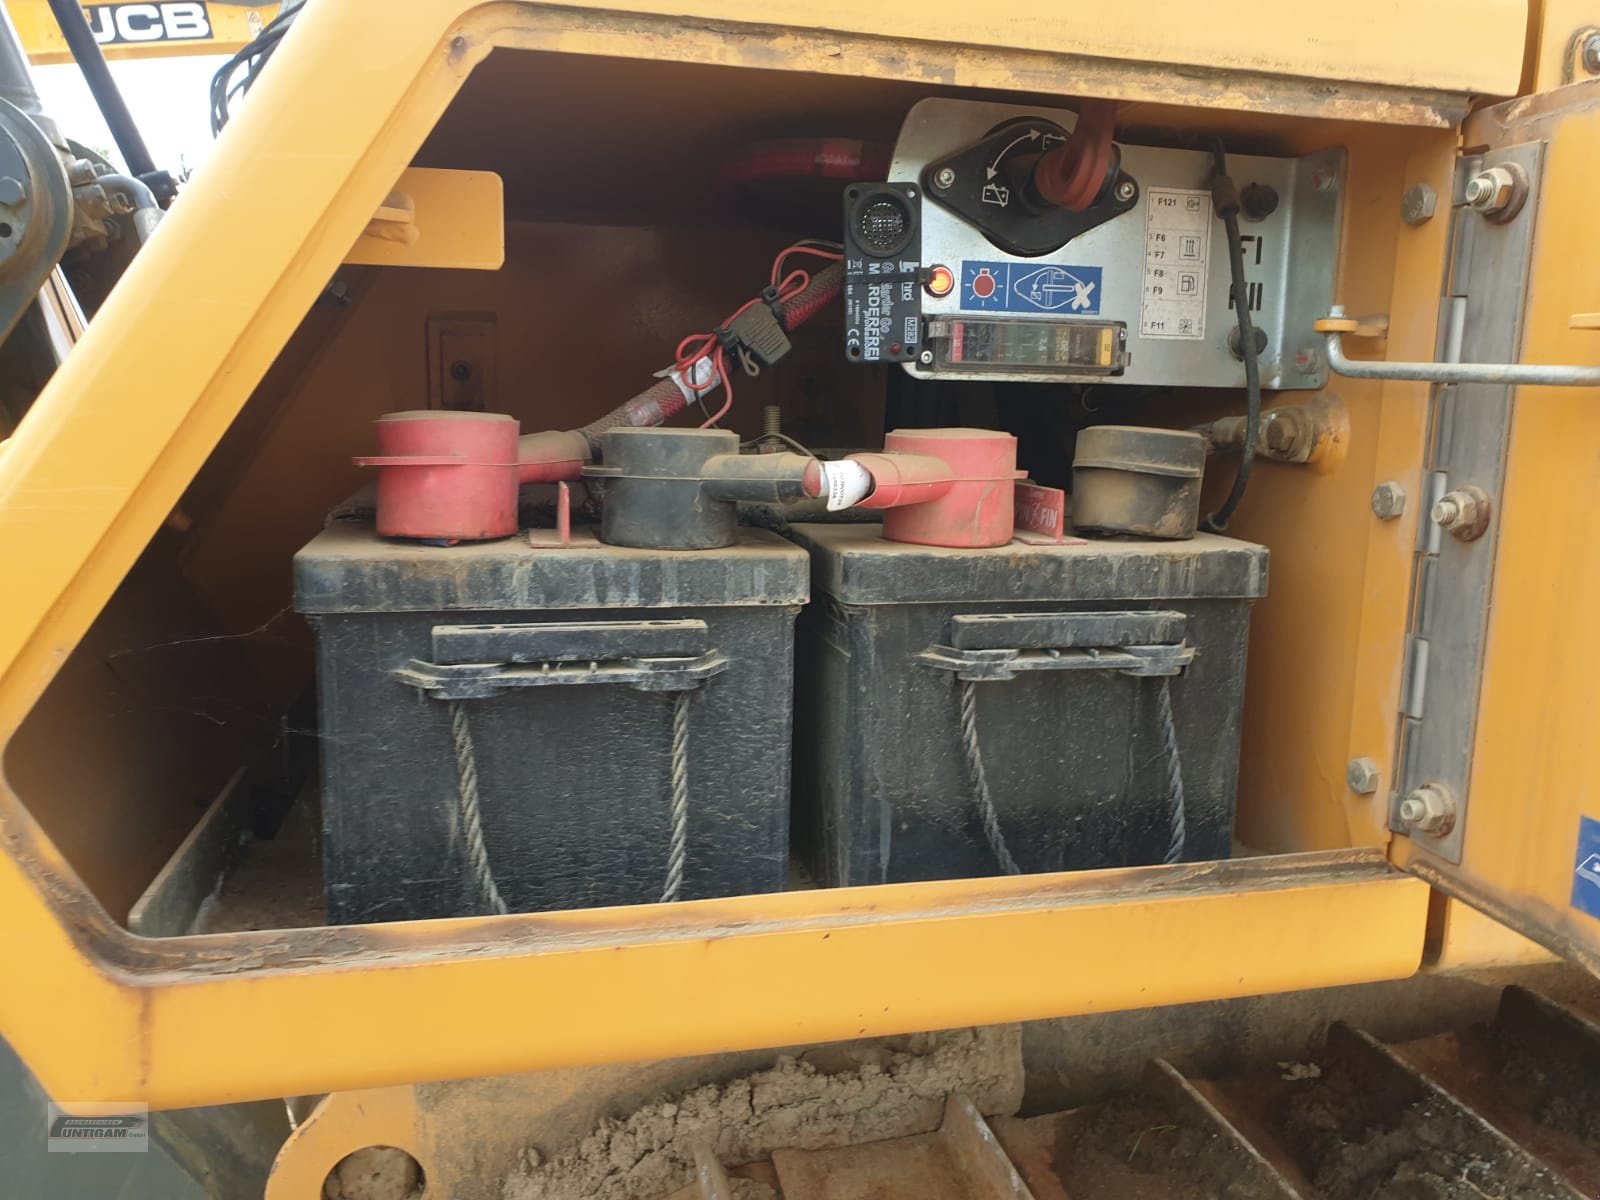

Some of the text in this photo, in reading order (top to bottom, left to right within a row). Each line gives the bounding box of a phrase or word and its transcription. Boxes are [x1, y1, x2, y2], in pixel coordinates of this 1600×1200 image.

[92, 2, 210, 43] JCB
[1158, 197, 1177, 207] F121
[1155, 233, 1166, 242] F6
[1154, 251, 1165, 259] F7
[1153, 269, 1164, 277] F8
[1152, 286, 1163, 295] F9
[868, 263, 880, 360] MRDERFREI
[1150, 321, 1165, 330] F11
